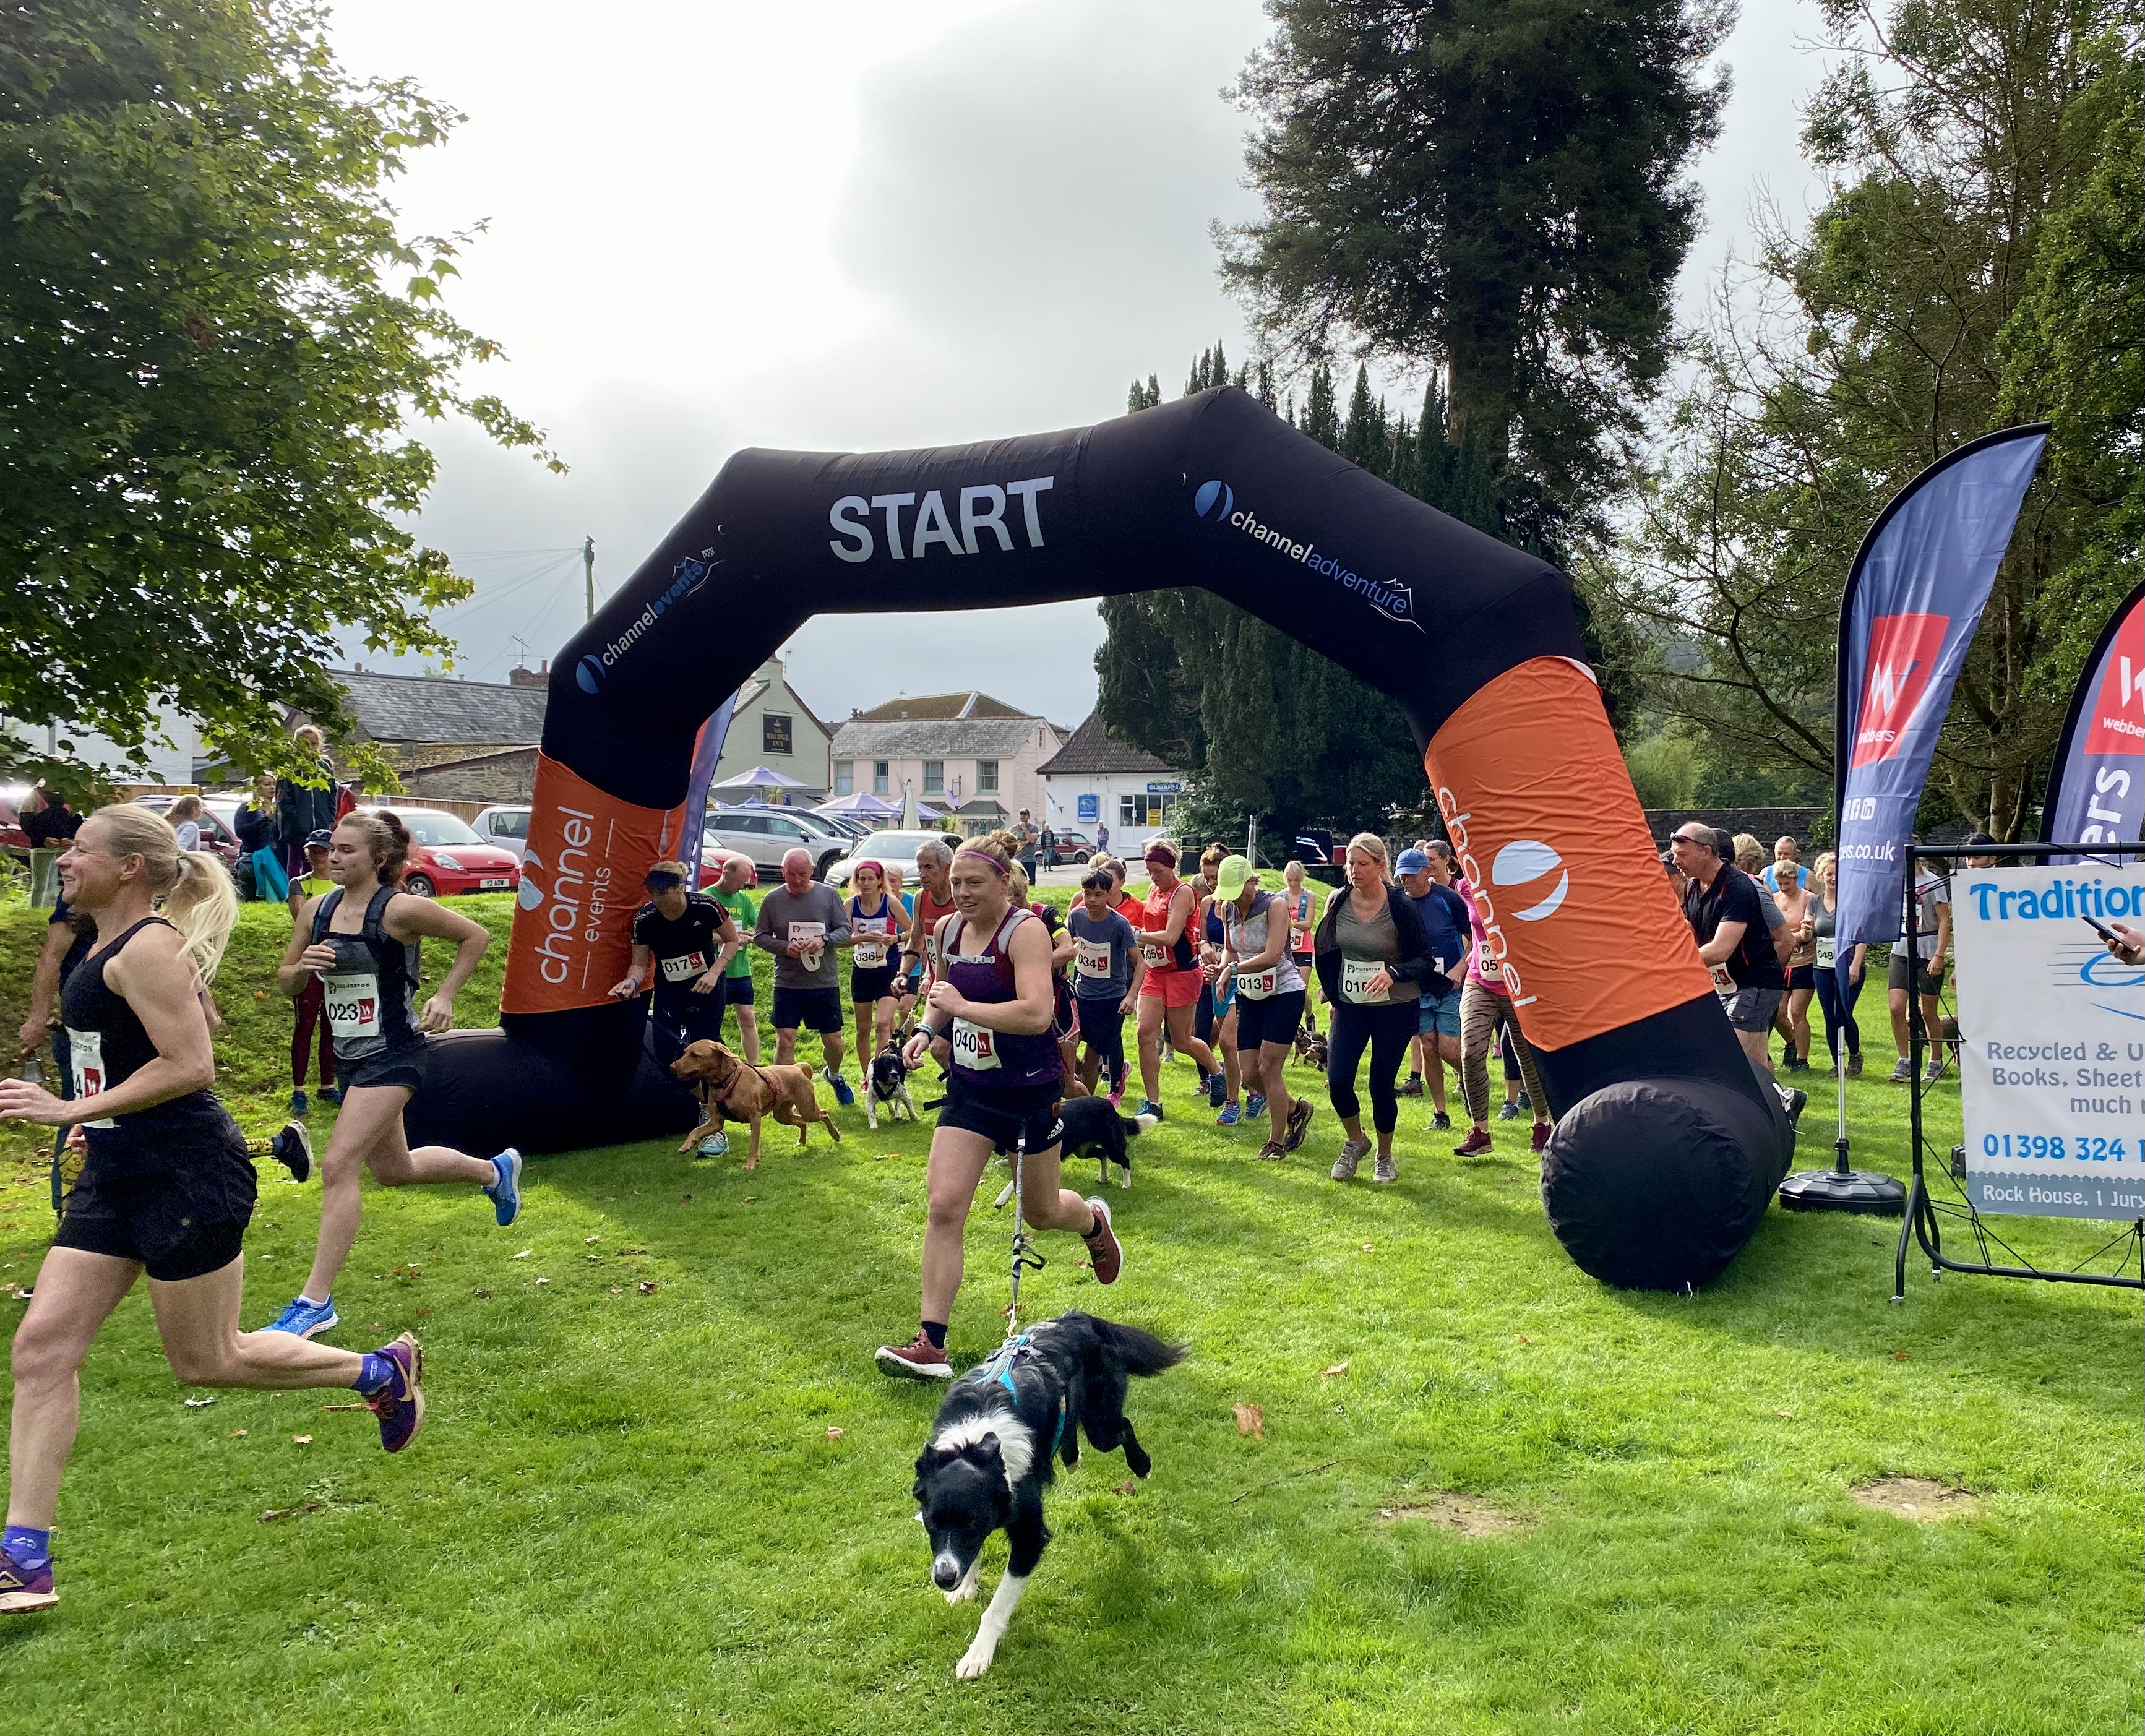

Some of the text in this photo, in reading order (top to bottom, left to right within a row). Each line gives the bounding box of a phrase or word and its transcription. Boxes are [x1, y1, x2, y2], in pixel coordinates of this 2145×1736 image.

[830, 476, 1054, 562] START
[1231, 511, 1407, 614] channeladventure
[535, 806, 594, 984] channel
[585, 867, 611, 942] events
[1439, 786, 1537, 1007] channel
[664, 959, 689, 973] 017
[856, 952, 875, 961] 036
[1078, 953, 1097, 968] 034
[1239, 978, 1262, 990] 013
[1711, 973, 1721, 984] 2
[329, 1003, 358, 1021] 023
[955, 1029, 976, 1052] 040
[1988, 1042, 2086, 1060] Recycled
[2096, 1042, 2117, 1061] &
[1992, 1068, 2143, 1088] Books, Sheet
[2071, 1095, 2131, 1114] much
[1984, 1133, 2065, 1159] 01398
[2076, 1137, 2126, 1162] 324
[1983, 1185, 2024, 1202] Rock
[2029, 1187, 2089, 1206] House,
[2096, 1190, 2102, 1206] 1
